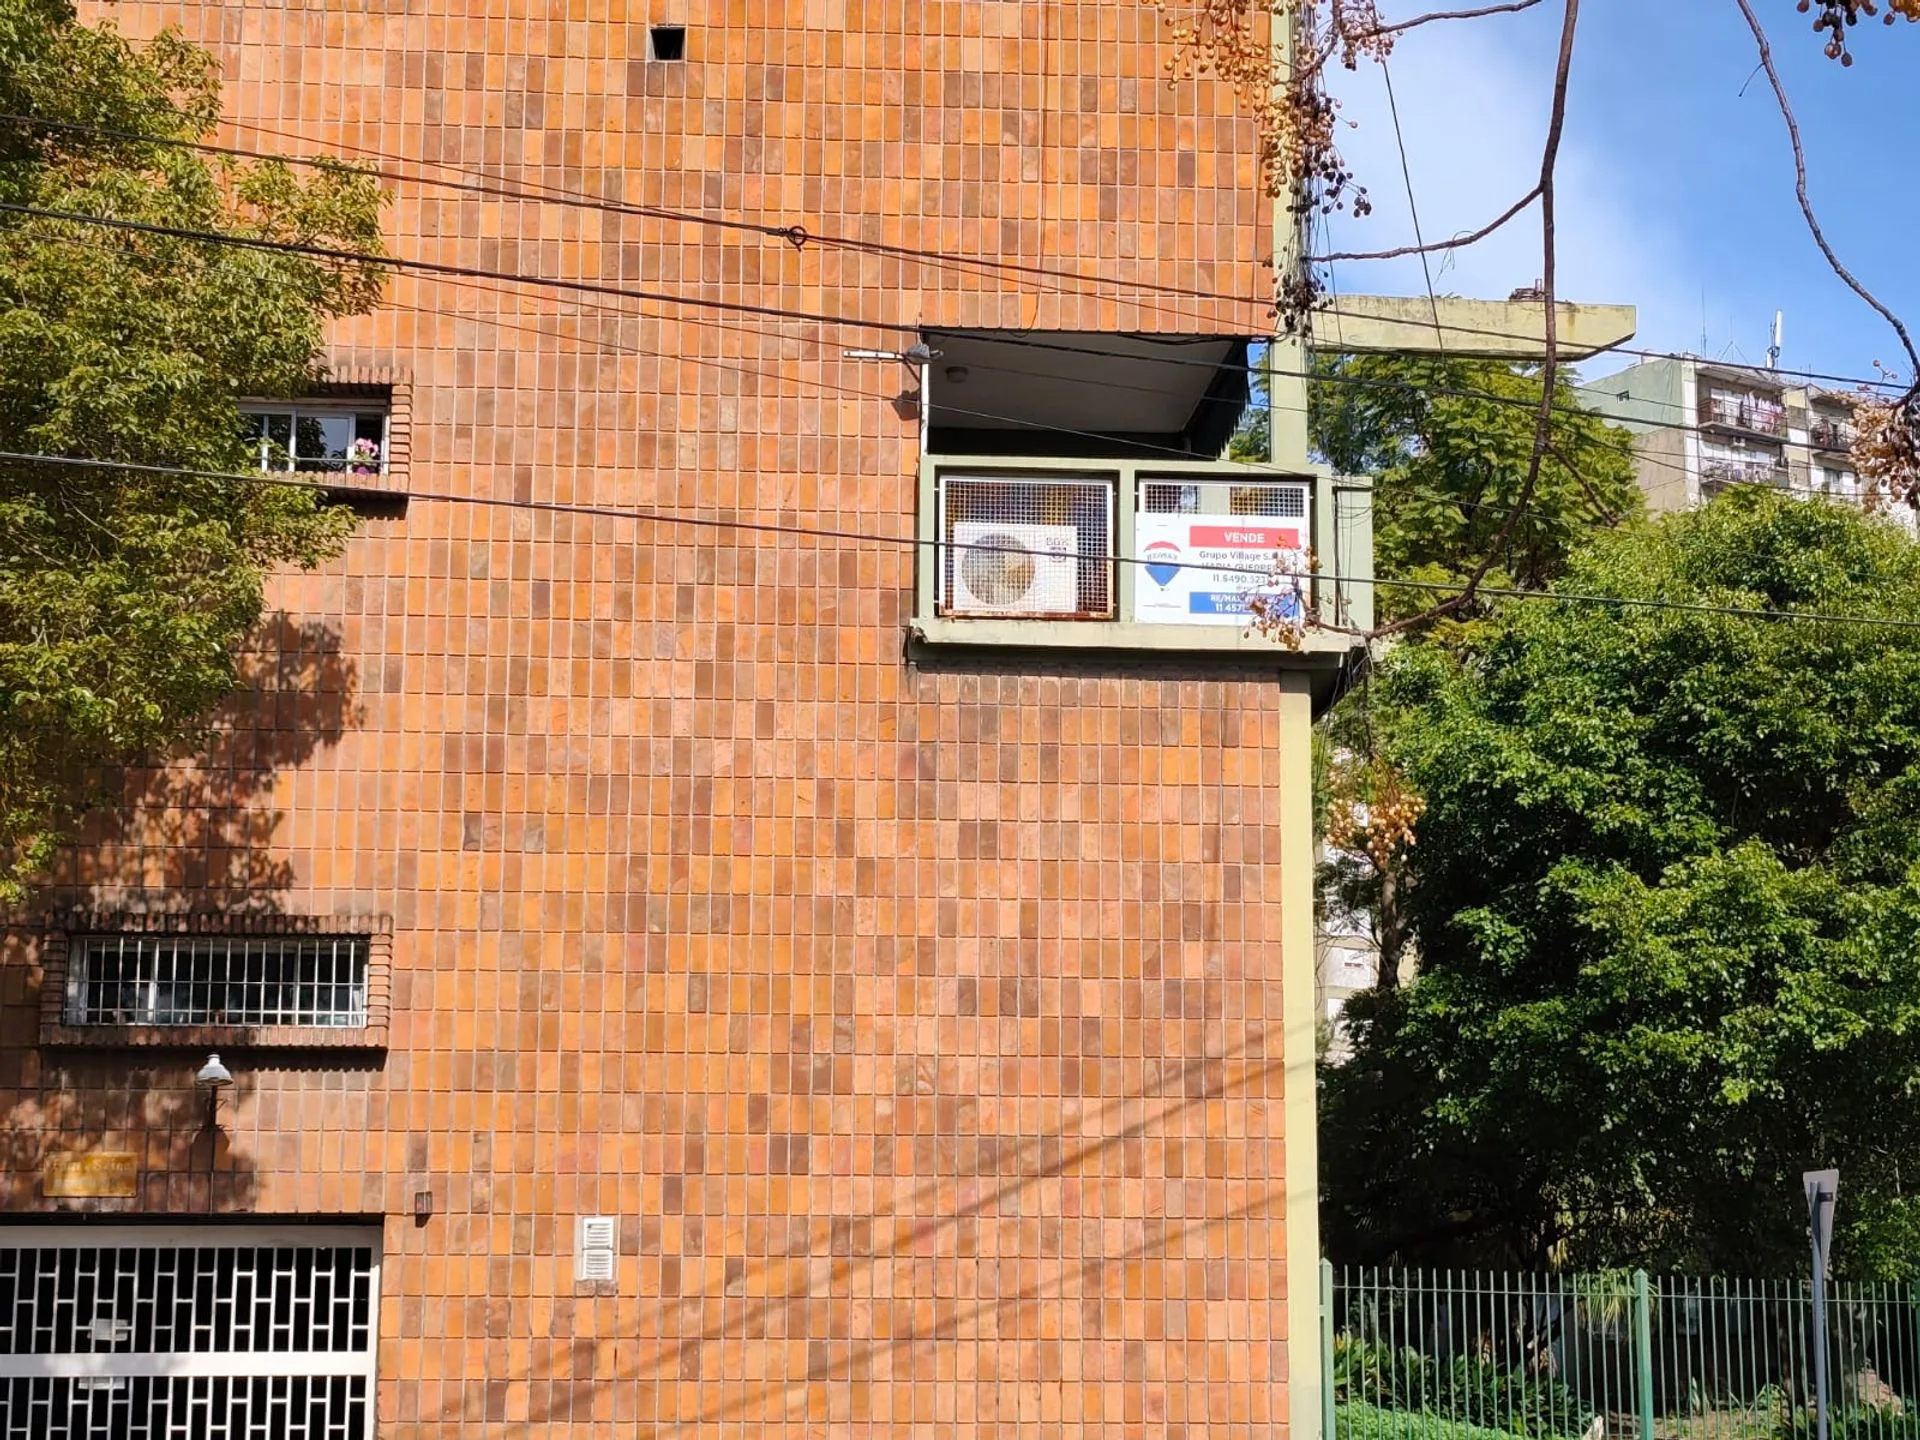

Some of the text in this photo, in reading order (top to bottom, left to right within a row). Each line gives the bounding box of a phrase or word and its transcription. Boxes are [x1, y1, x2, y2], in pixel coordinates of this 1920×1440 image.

[1223, 531, 1265, 544] VENDE
[1199, 550, 1228, 561] Grupo
[1229, 551, 1262, 562] Village
